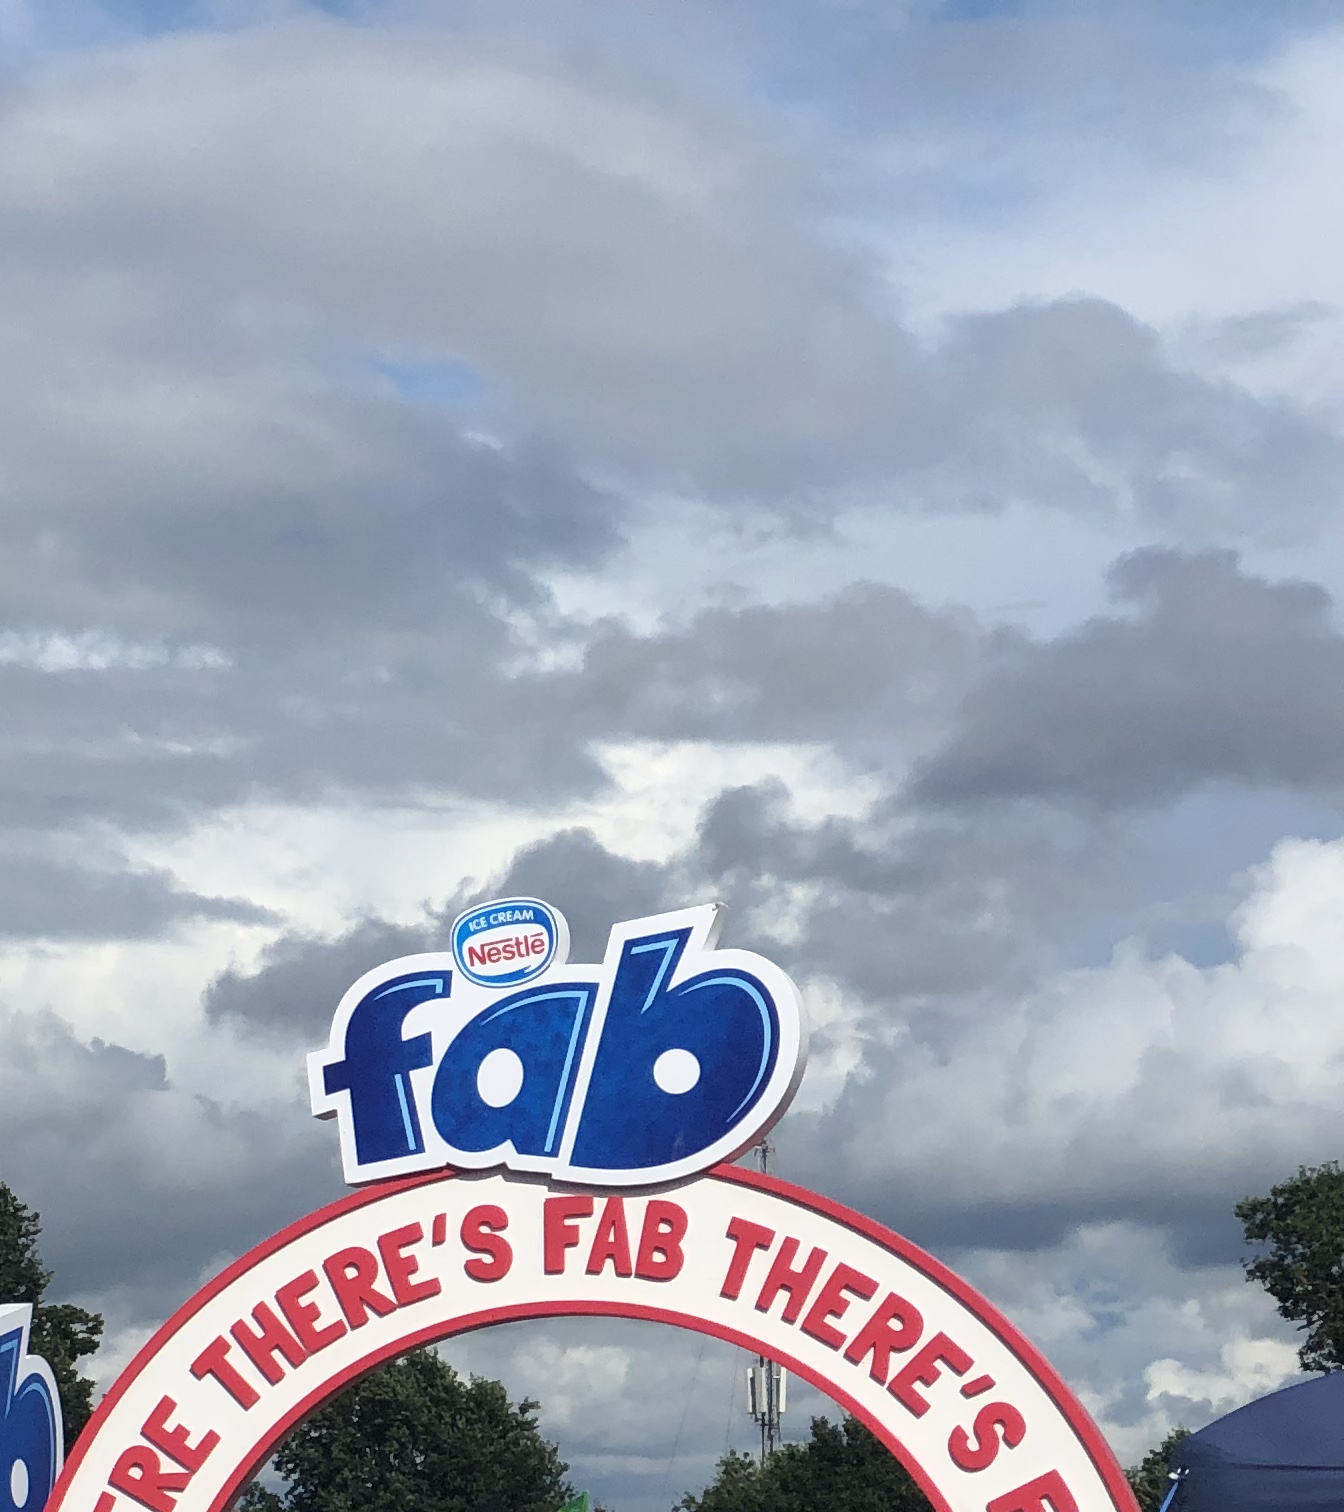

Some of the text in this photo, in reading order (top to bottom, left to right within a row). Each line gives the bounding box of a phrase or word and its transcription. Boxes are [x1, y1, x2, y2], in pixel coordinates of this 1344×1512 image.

[468, 932, 545, 967] Nestlé
[469, 910, 534, 932] ICE CREAM
[322, 926, 780, 1170] fab
[190, 1205, 513, 1411] THERE'S
[543, 1196, 688, 1281] FAB
[719, 1217, 1027, 1473] THERE'S
